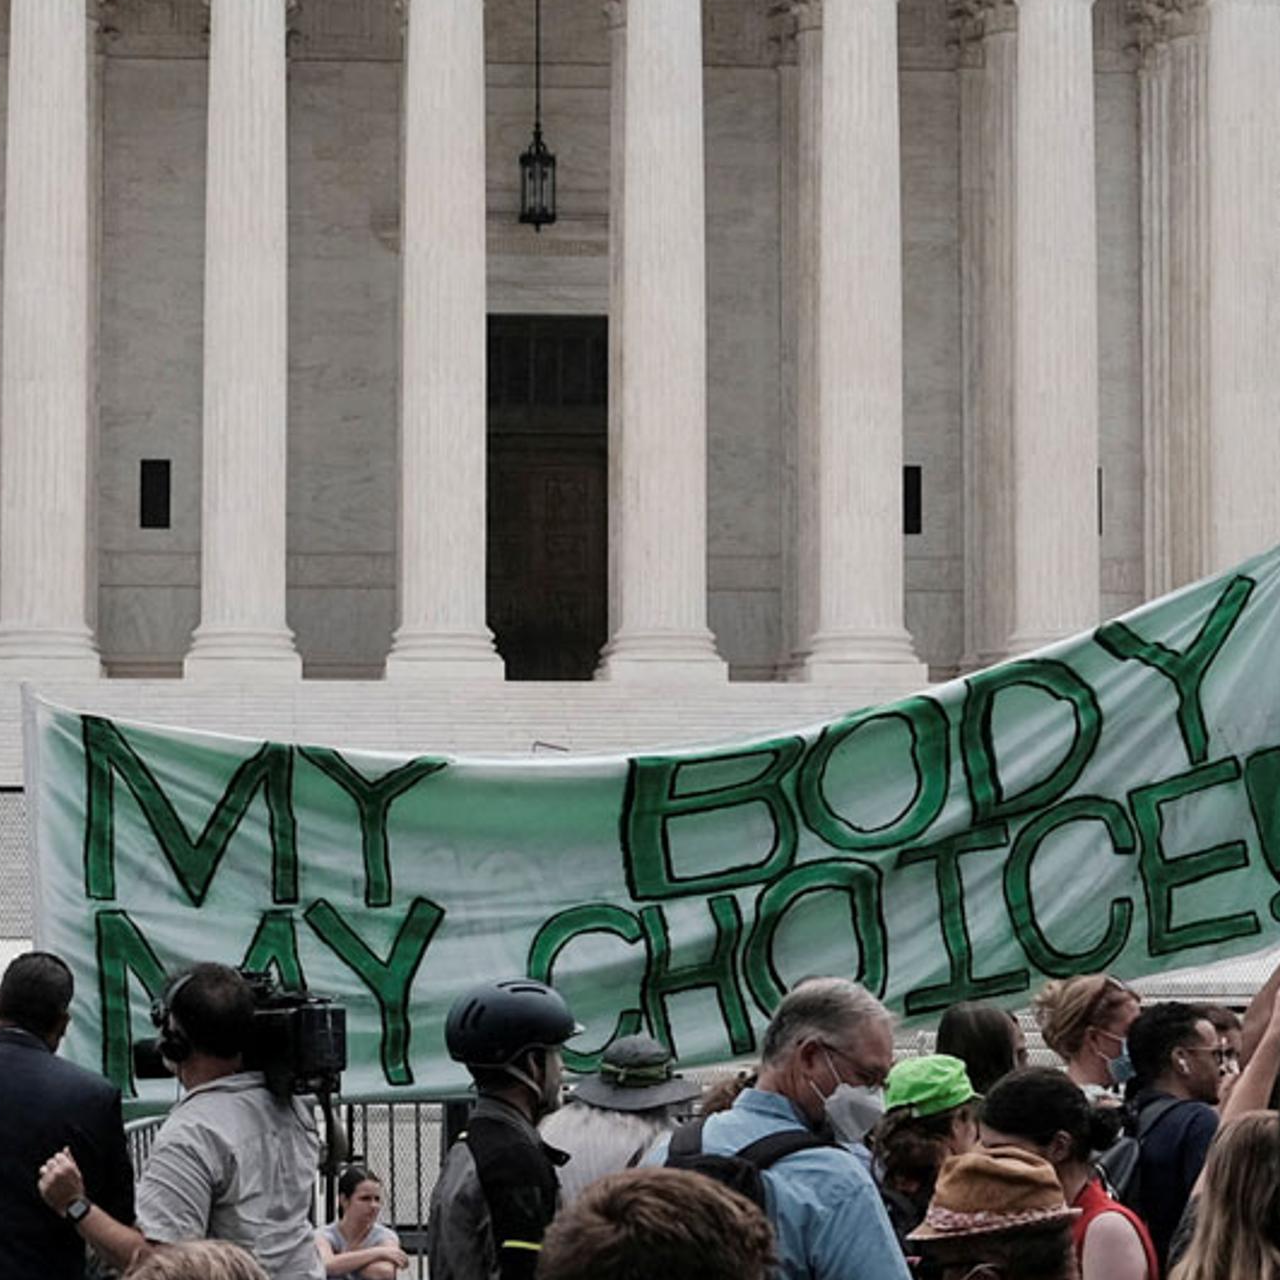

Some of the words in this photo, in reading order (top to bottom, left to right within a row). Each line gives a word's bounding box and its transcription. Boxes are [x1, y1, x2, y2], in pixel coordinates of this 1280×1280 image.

[81, 714, 448, 907] MY
[620, 574, 1257, 901] BODY
[96, 896, 446, 1098] MY
